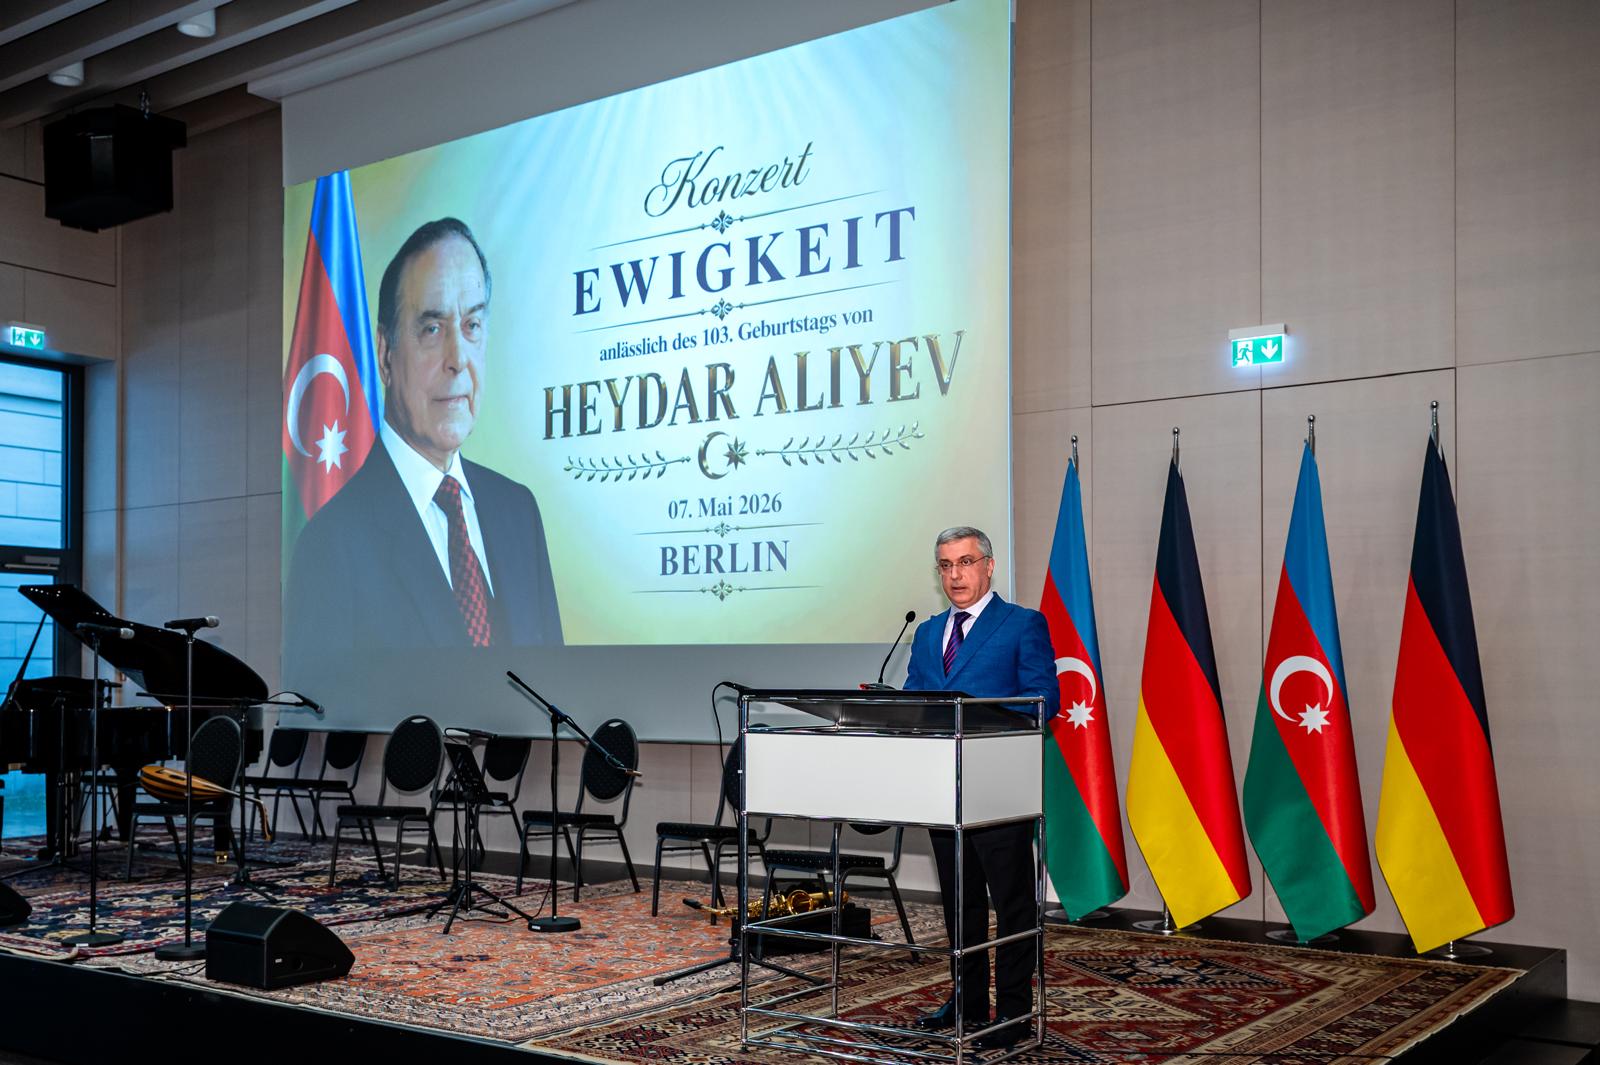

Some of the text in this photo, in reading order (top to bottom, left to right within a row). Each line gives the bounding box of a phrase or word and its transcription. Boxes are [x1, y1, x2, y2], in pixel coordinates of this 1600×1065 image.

[643, 140, 814, 218] Konzert
[572, 206, 916, 316] EWIGKEIT
[600, 308, 873, 361] anlässlich des 103. Geburtstags von
[543, 329, 967, 440] HEYDAR ALIYEV
[668, 493, 783, 520] 07. Mai 2026
[660, 540, 790, 576] BERLIN
